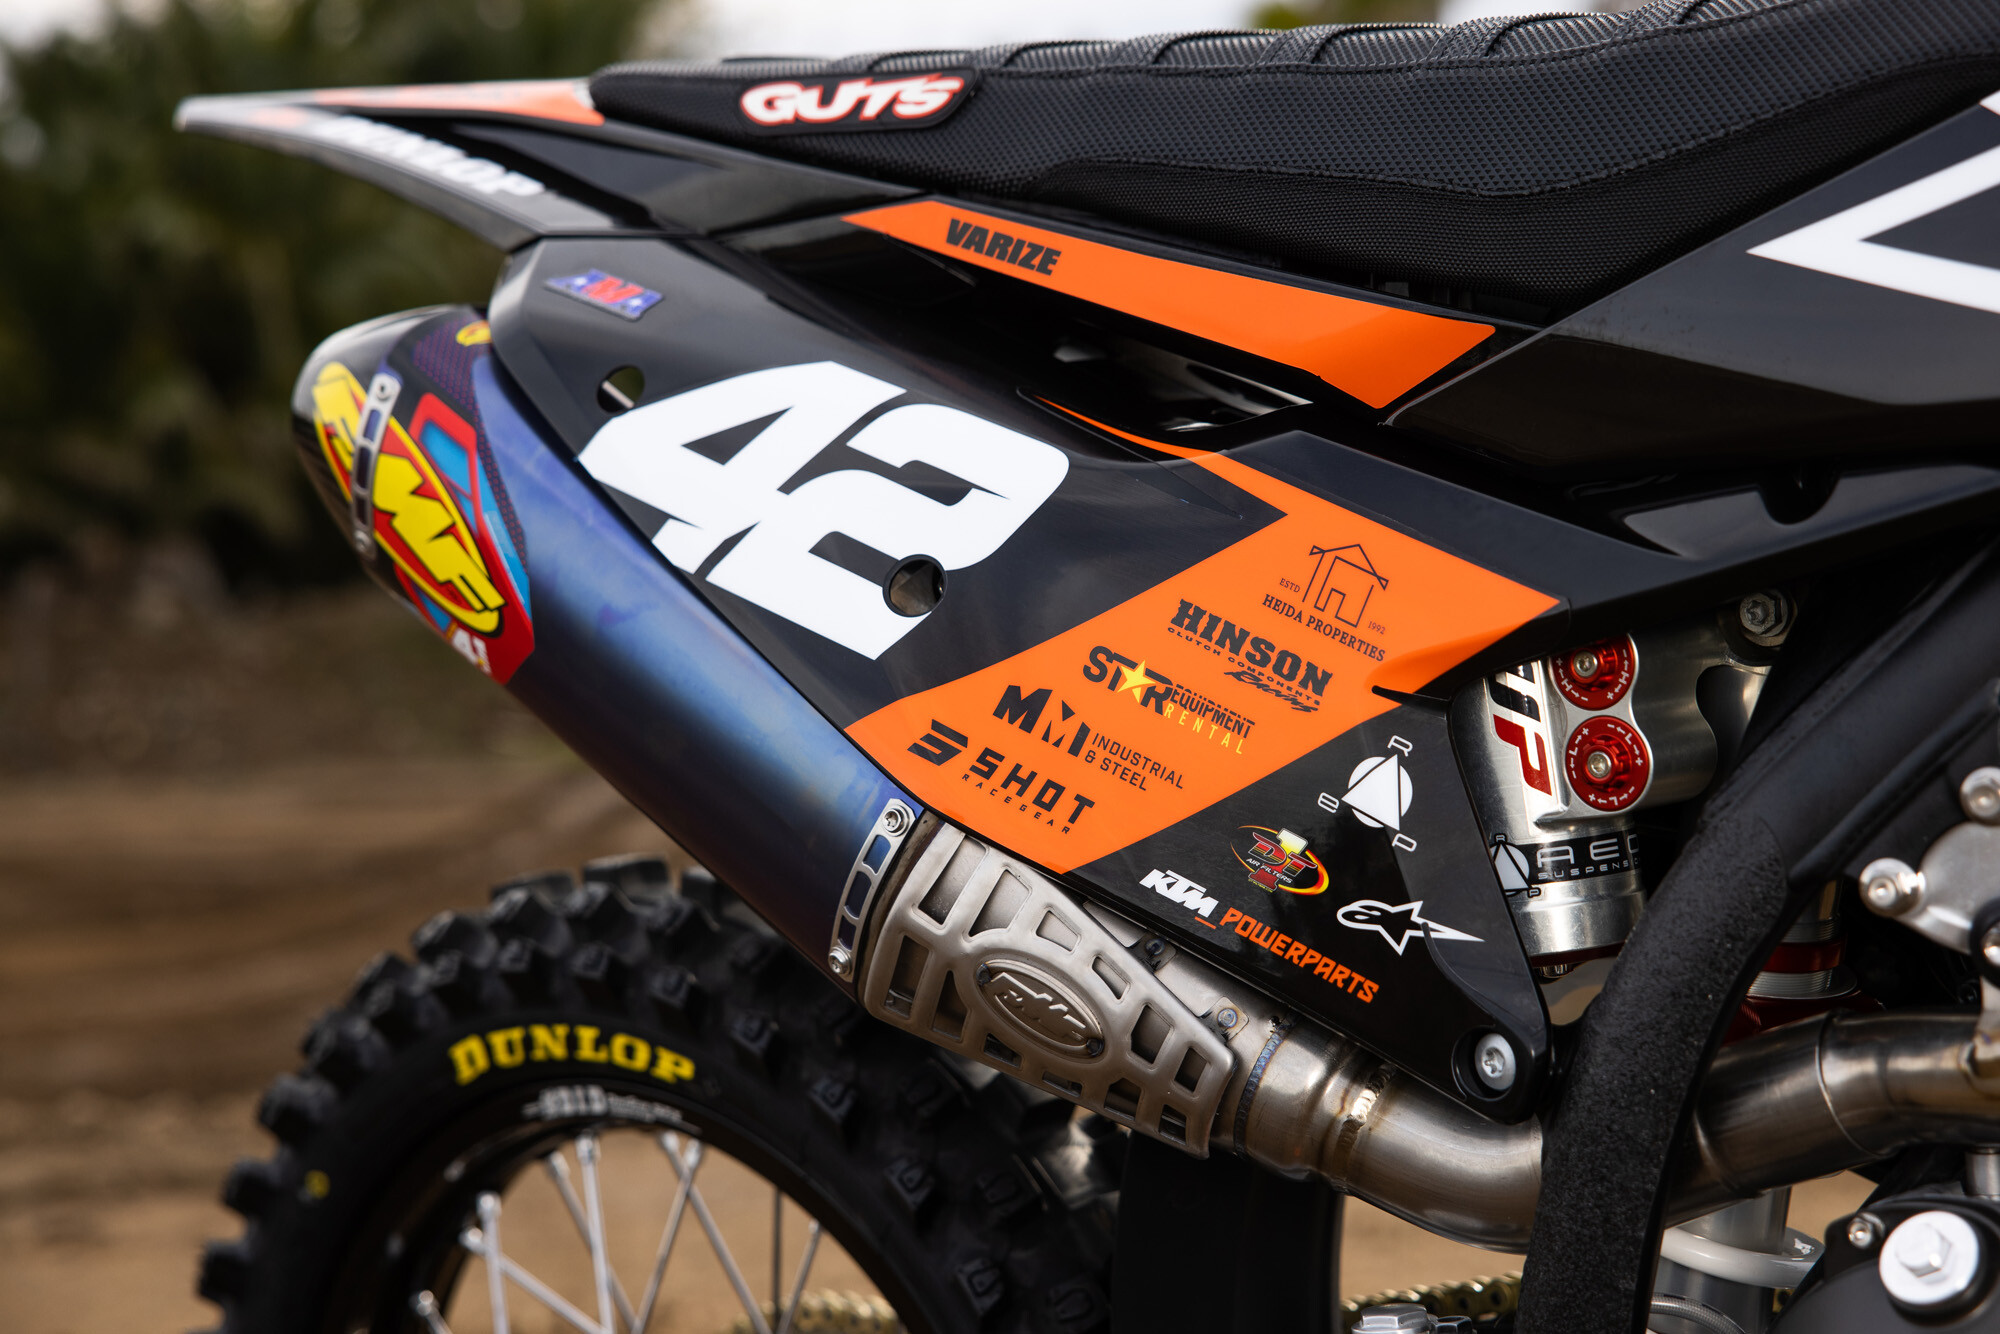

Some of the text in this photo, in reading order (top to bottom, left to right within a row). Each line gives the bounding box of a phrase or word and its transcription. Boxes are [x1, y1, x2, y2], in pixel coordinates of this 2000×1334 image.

[740, 73, 965, 127] GUTS
[945, 218, 1062, 276] VARIZE
[575, 360, 1070, 661] 42
[1279, 578, 1301, 593] ESTD
[1170, 599, 1333, 697] HINSON
[1262, 594, 1386, 662] HEJDA PROPERTIES
[1367, 621, 1386, 635] 1992
[1167, 627, 1321, 706] CLUTCH COMPONENTS
[1224, 670, 1319, 713] Racing
[1163, 702, 1244, 755] RENTAL
[1169, 683, 1256, 739] EQUIPMENT
[1084, 750, 1148, 792] & STEEL
[1092, 732, 1184, 790] INDUSTRIAL
[1387, 734, 1414, 757] R
[969, 746, 1096, 825] SHOT
[1138, 868, 1220, 919] KTM
[1246, 857, 1293, 884] AIR FILTERS
[449, 1022, 696, 1085] DUNLOP
